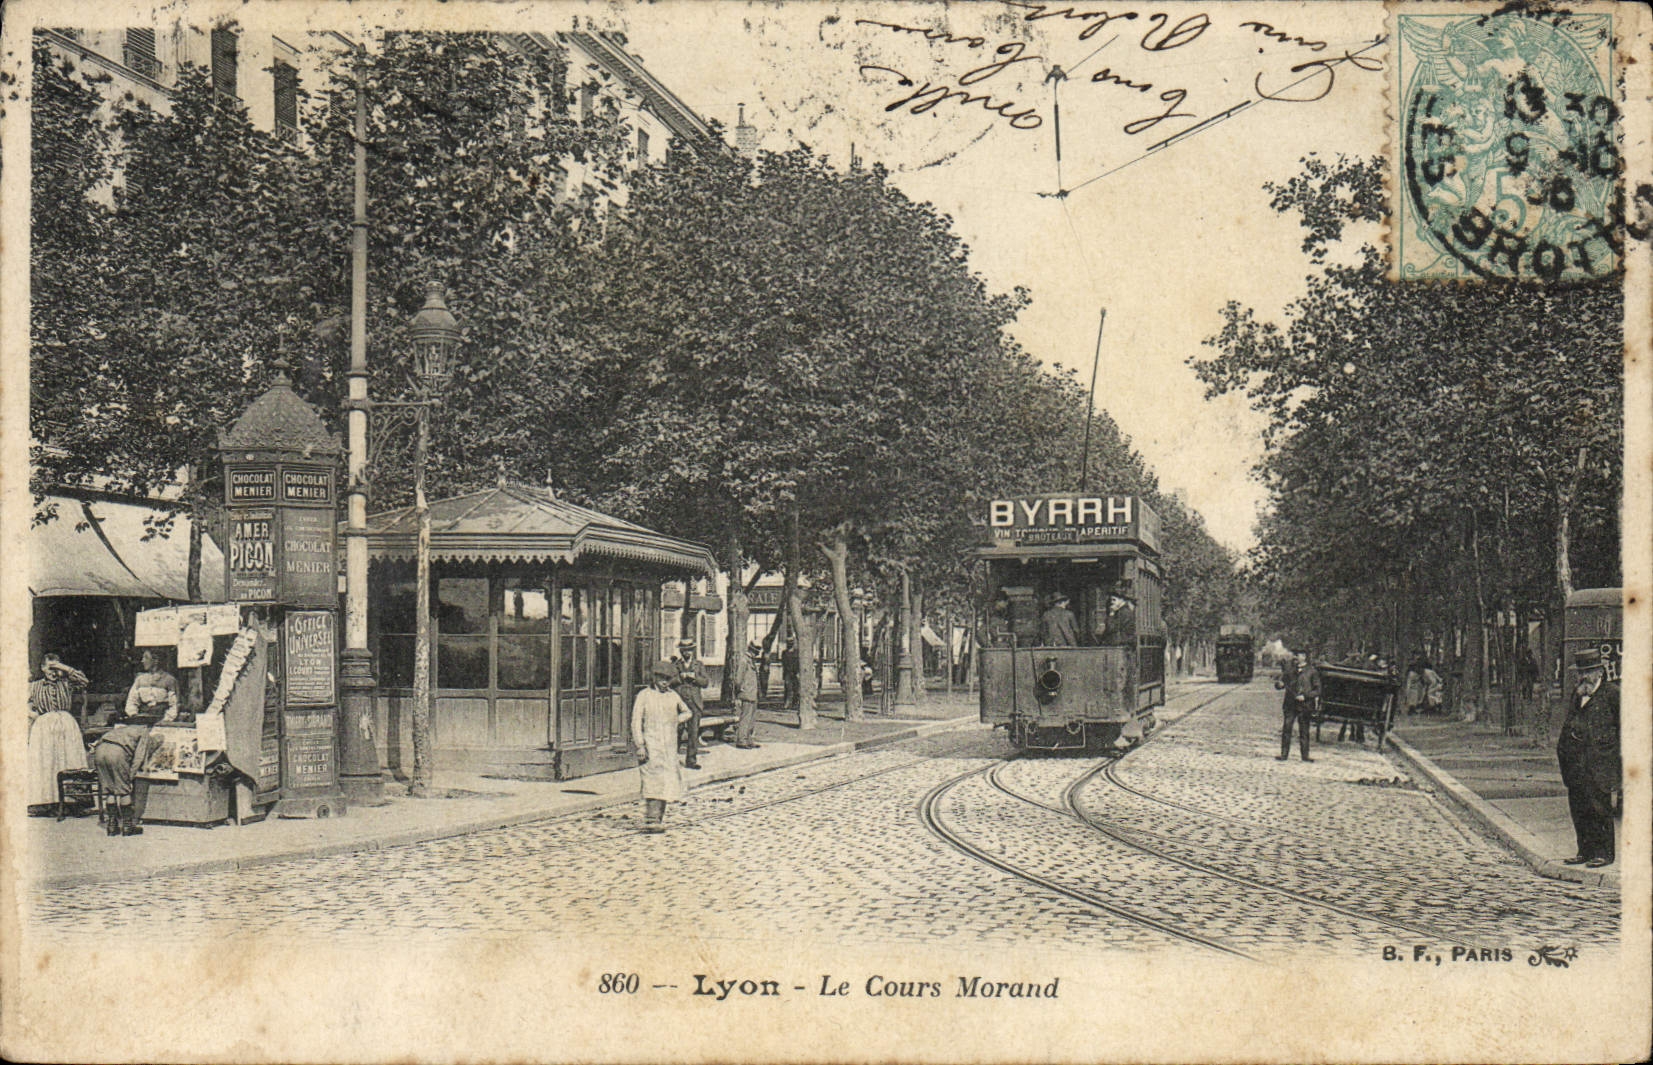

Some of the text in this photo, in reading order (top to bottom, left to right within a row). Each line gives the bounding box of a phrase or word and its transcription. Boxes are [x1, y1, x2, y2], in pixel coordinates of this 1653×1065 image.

[232, 474, 273, 484] CHOCOLAT
[285, 474, 328, 486] CHOCOLAT
[234, 486, 272, 497] MENIER
[287, 486, 326, 498] MENIER
[990, 497, 1132, 527] BYRRH
[235, 522, 269, 539] AMER
[994, 529, 1010, 539] VIN
[284, 540, 331, 553] CHOCOLAT
[229, 541, 274, 571] PICON
[286, 560, 330, 573] MENIER
[295, 763, 327, 774] MENIER
